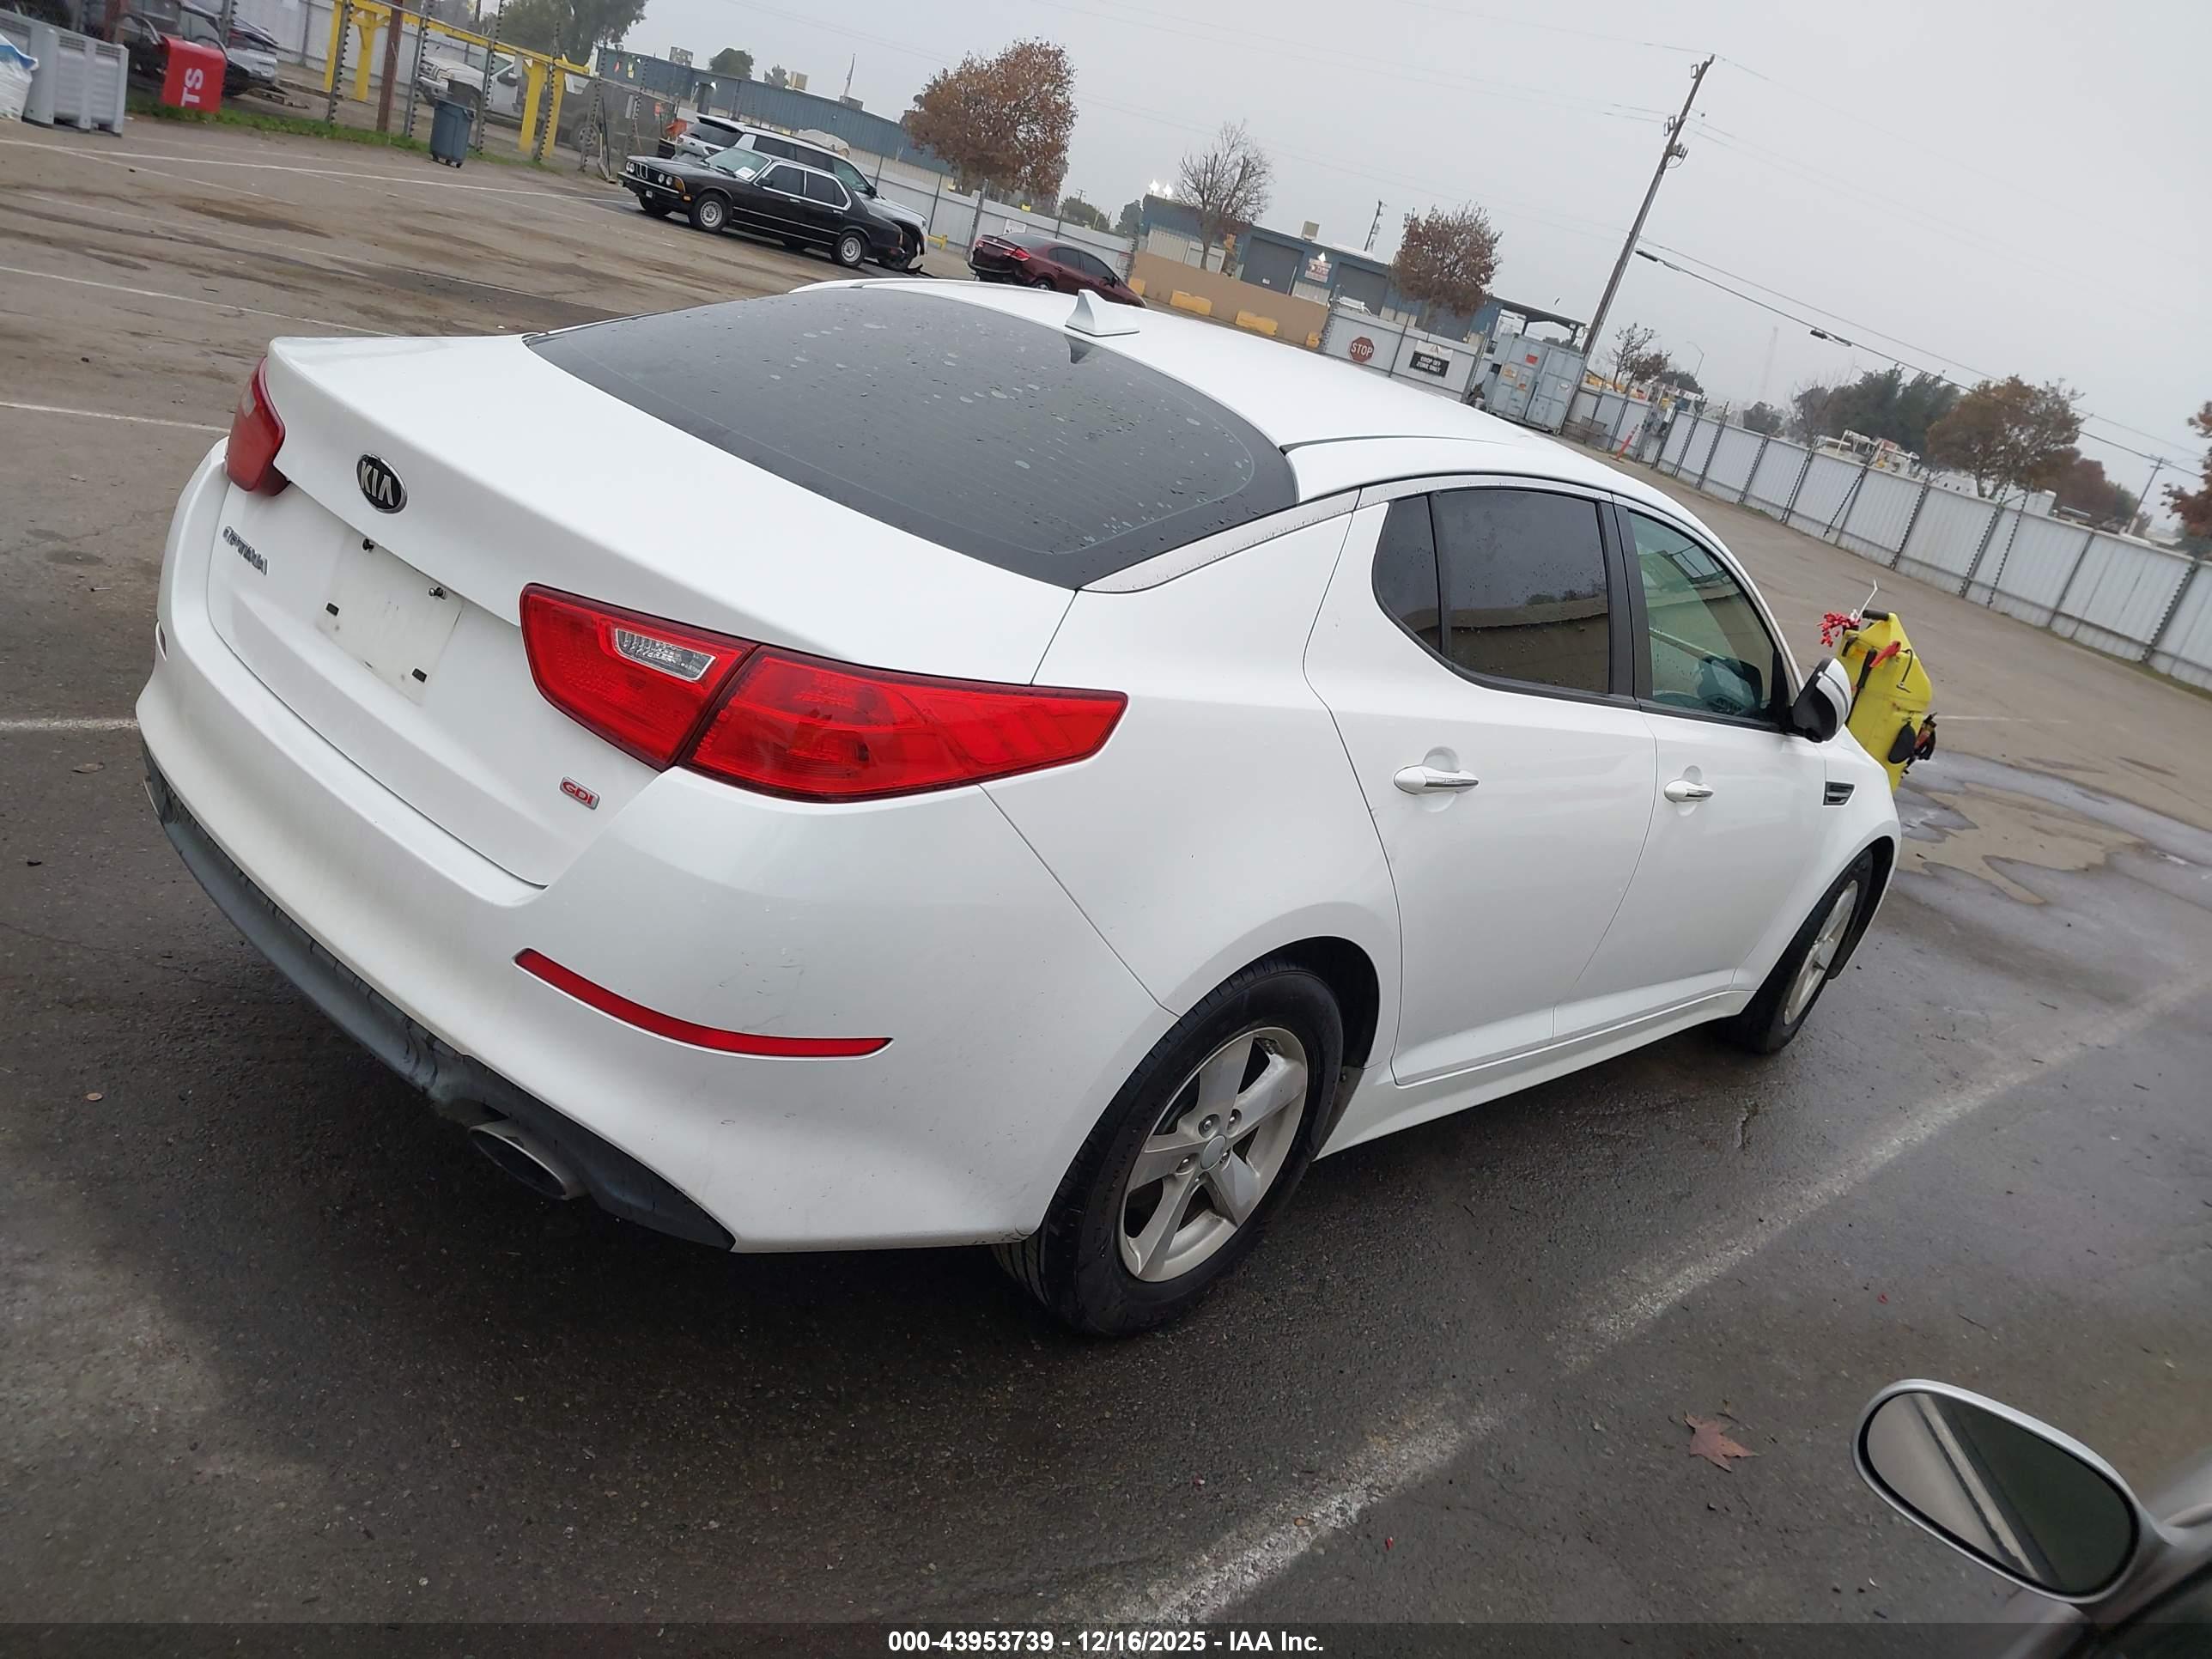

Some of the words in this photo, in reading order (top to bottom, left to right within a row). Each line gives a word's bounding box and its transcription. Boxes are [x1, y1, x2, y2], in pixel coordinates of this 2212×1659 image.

[180, 68, 204, 106] TS
[1351, 343, 1373, 358] STOP
[361, 460, 394, 507] KIA
[223, 526, 268, 576] OPTIMA
[562, 781, 594, 805] GDI
